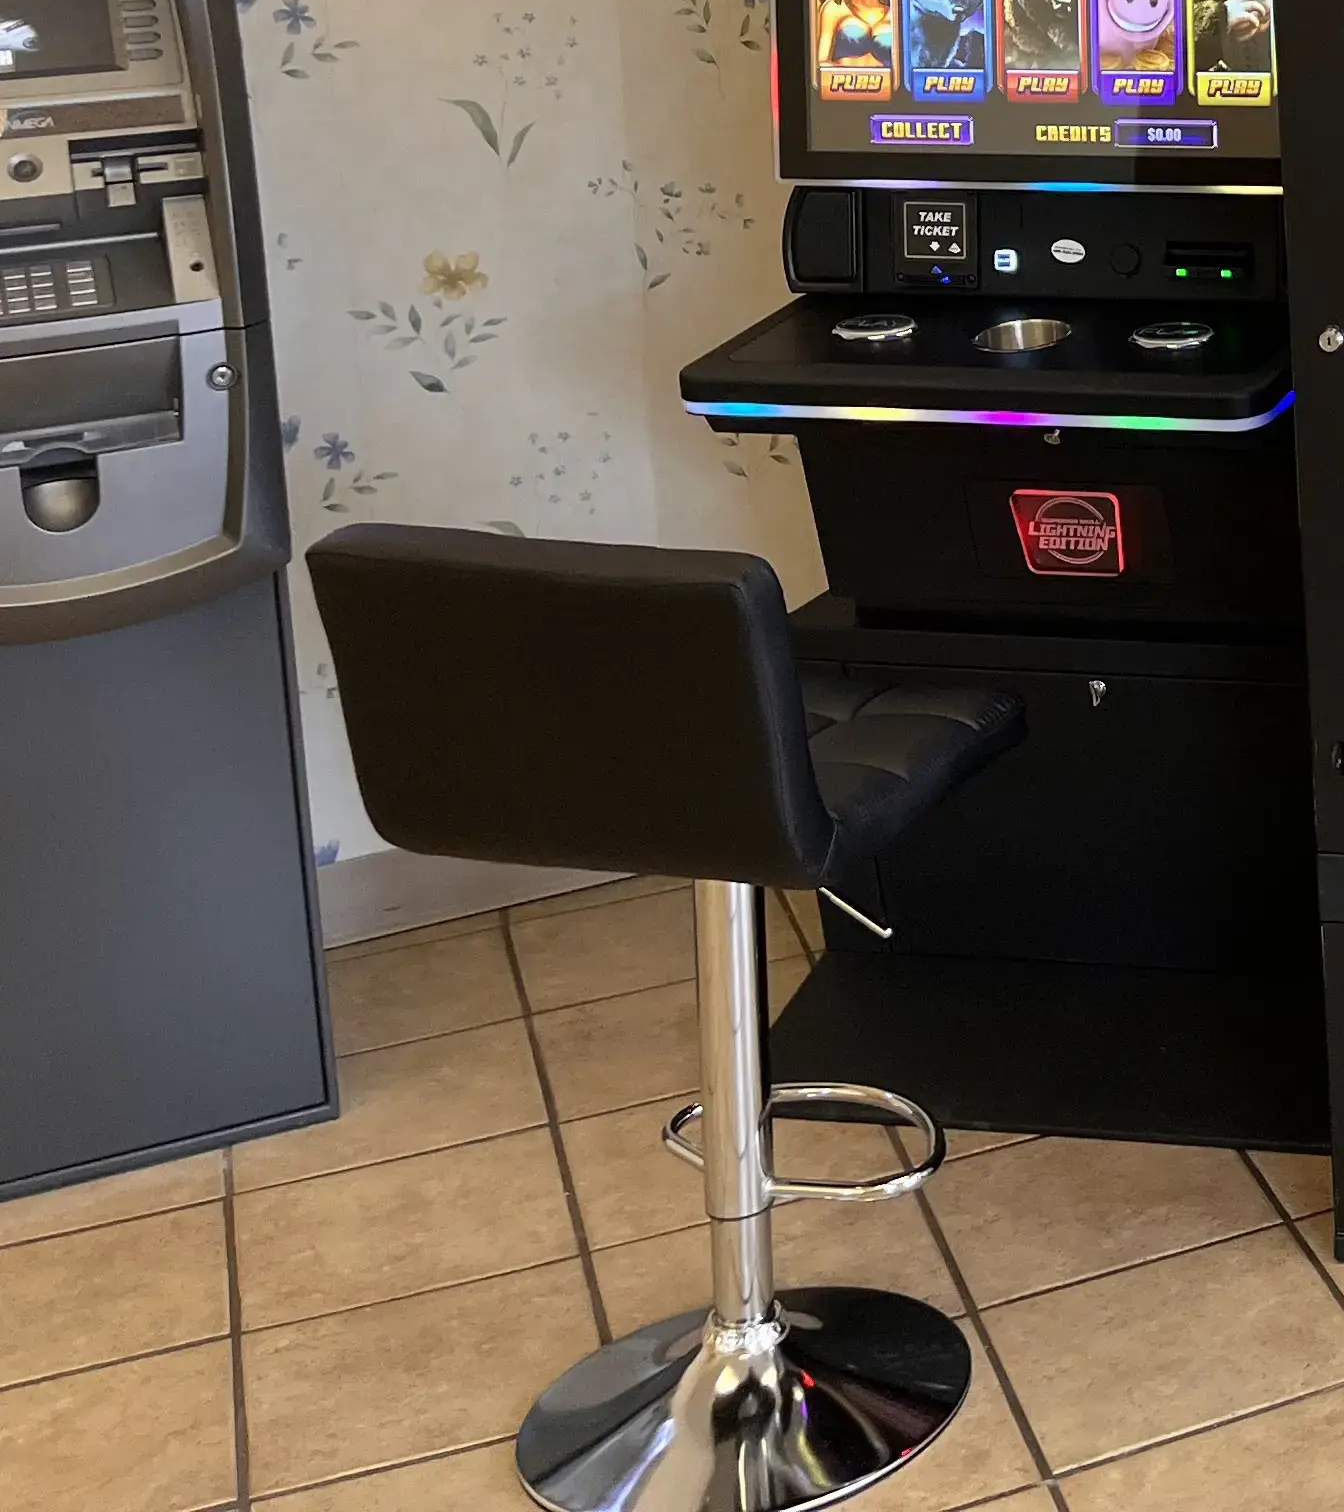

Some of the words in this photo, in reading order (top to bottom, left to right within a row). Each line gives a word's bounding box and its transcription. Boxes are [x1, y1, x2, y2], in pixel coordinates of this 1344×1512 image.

[830, 74, 882, 93] PLAY
[923, 74, 975, 93] PLAY
[1017, 76, 1070, 95] PLAY
[1112, 77, 1165, 96] PLAY
[1207, 78, 1262, 98] PLAY
[880, 121, 965, 143] COLLECT
[1035, 124, 1113, 144] CREDITS
[1146, 126, 1183, 144] $0.00
[919, 211, 952, 223] TAKE
[912, 225, 960, 237] TICKET
[1028, 520, 1117, 539] LIGHTNING
[1038, 536, 1109, 551] EDITION
